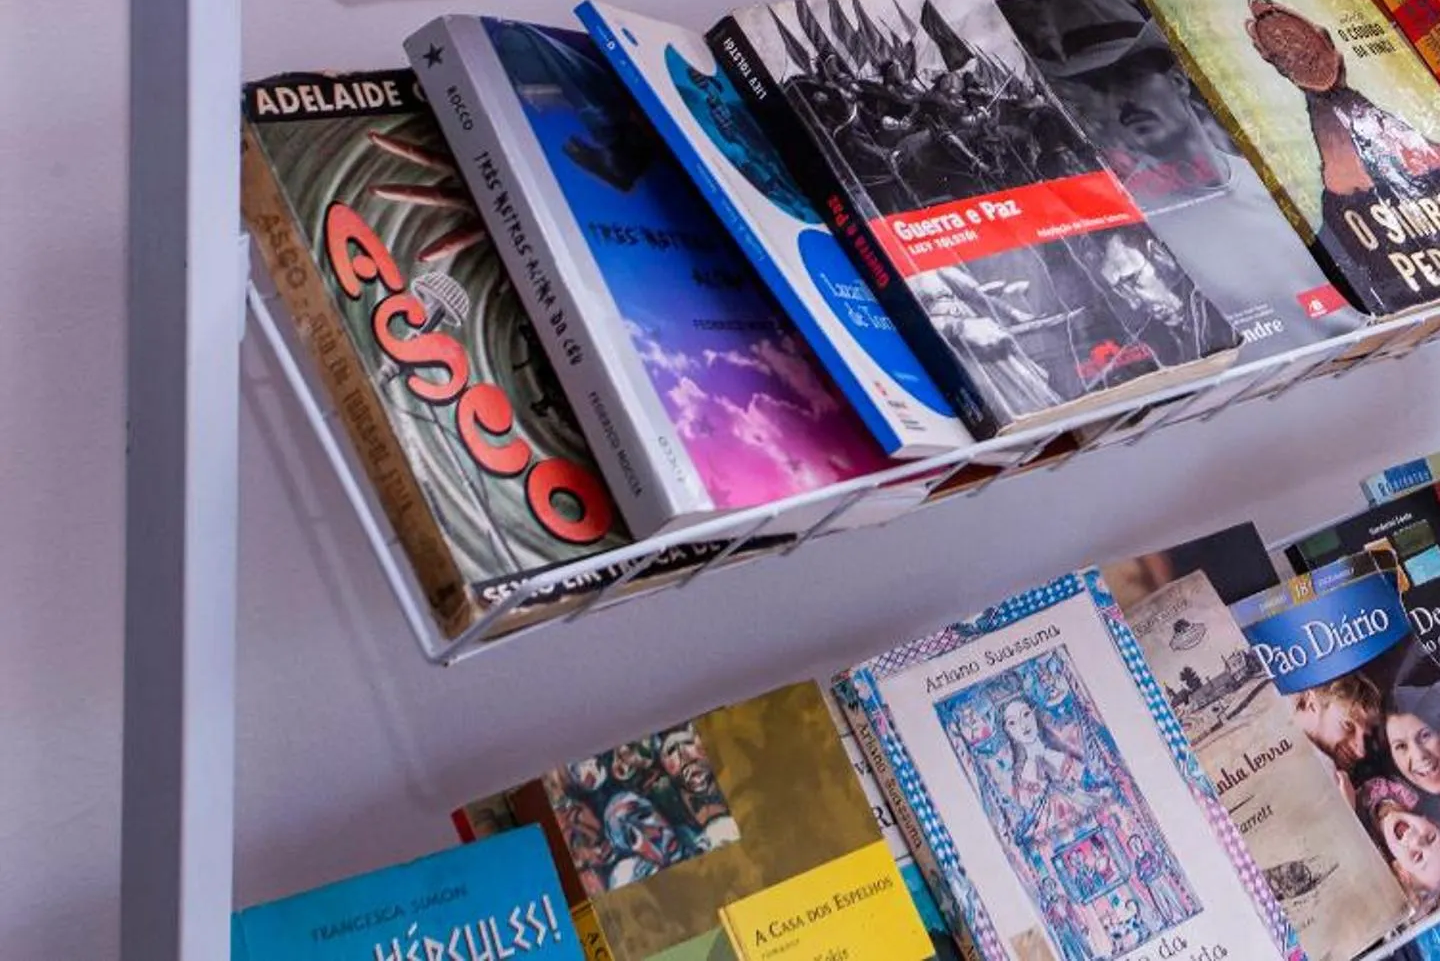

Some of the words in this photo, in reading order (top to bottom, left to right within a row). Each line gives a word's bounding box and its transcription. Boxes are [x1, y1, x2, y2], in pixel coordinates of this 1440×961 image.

[1337, 29, 1350, 43] O
[1352, 45, 1368, 59] DA
[255, 80, 404, 116] ADELAIDE
[748, 74, 769, 102] LIEV
[851, 235, 893, 292] Guerra
[893, 209, 966, 241] Guerra
[966, 209, 982, 226] e
[978, 198, 1022, 222] Paz
[1344, 209, 1380, 252] O
[473, 150, 503, 191] TRÊS
[549, 307, 569, 338] DO
[1240, 317, 1285, 342] ndre
[324, 199, 615, 545] ASCO
[924, 660, 980, 693] Ariano
[983, 623, 1061, 667] Suassuna
[1253, 641, 1309, 679] Pão
[1304, 607, 1390, 660] Diário
[857, 721, 888, 774] Ariano
[884, 774, 923, 850] Suassuna
[1214, 766, 1249, 798] nha
[1238, 804, 1275, 835] arrett
[311, 904, 405, 942] FRANCESCA
[409, 884, 469, 914] SIMON
[754, 928, 769, 948] A
[769, 917, 805, 938] CASA
[834, 875, 894, 911] ESPELHOS
[1158, 933, 1188, 961] da
